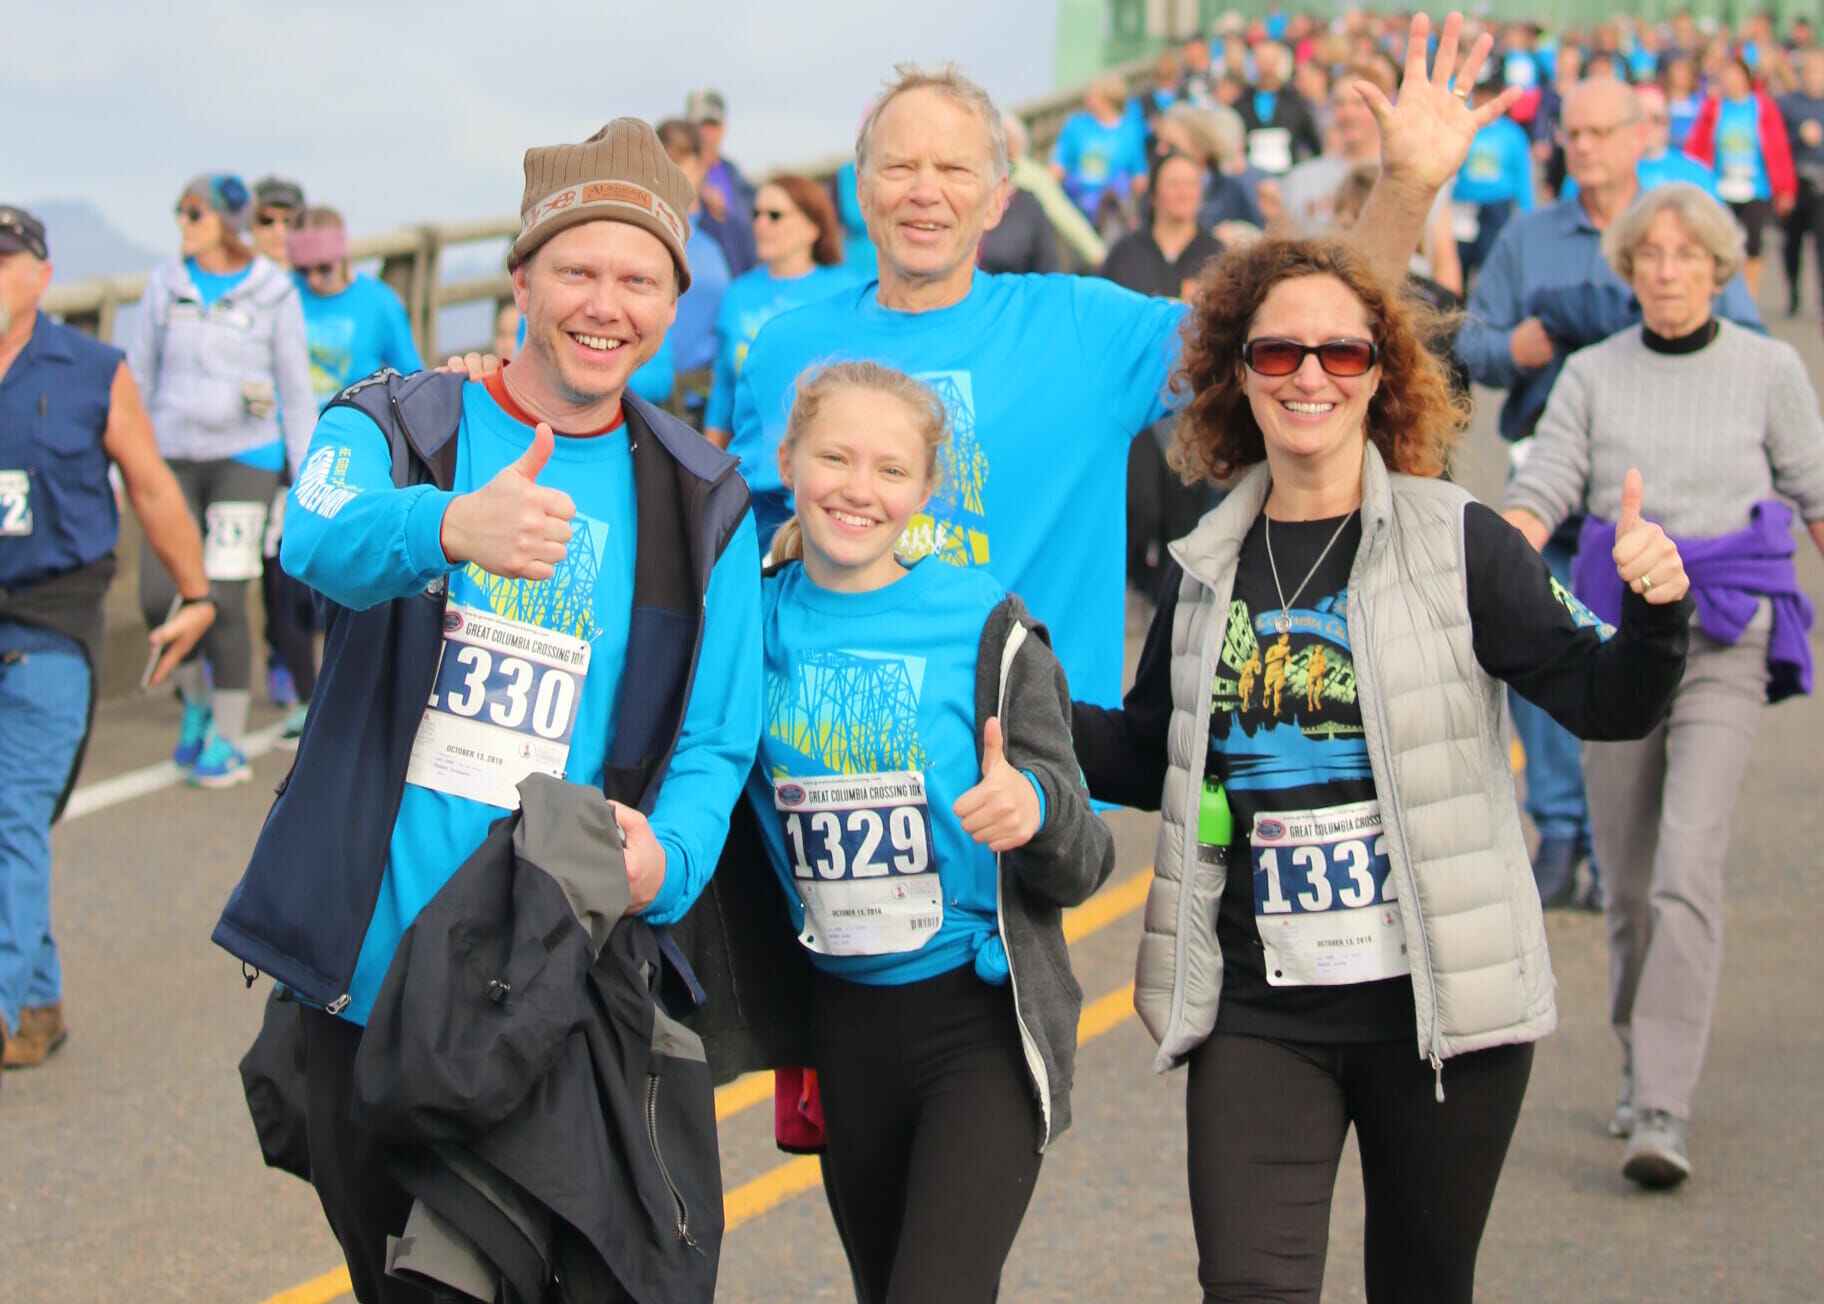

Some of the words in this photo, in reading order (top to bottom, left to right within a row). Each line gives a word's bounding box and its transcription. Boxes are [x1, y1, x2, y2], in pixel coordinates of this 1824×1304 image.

[466, 622, 491, 640] GREAT
[492, 628, 530, 650] COLUMBIA
[532, 637, 570, 663] CROSSING
[570, 649, 585, 667] 10K
[428, 640, 575, 739] 330
[808, 790, 829, 804] GREAT
[831, 787, 868, 803] COLUMBIA
[869, 785, 908, 800] CROSSING
[909, 783, 922, 796] 10K
[786, 806, 928, 880] 1329
[1289, 823, 1313, 839] GREAT
[1315, 818, 1354, 838] COLUMBIA
